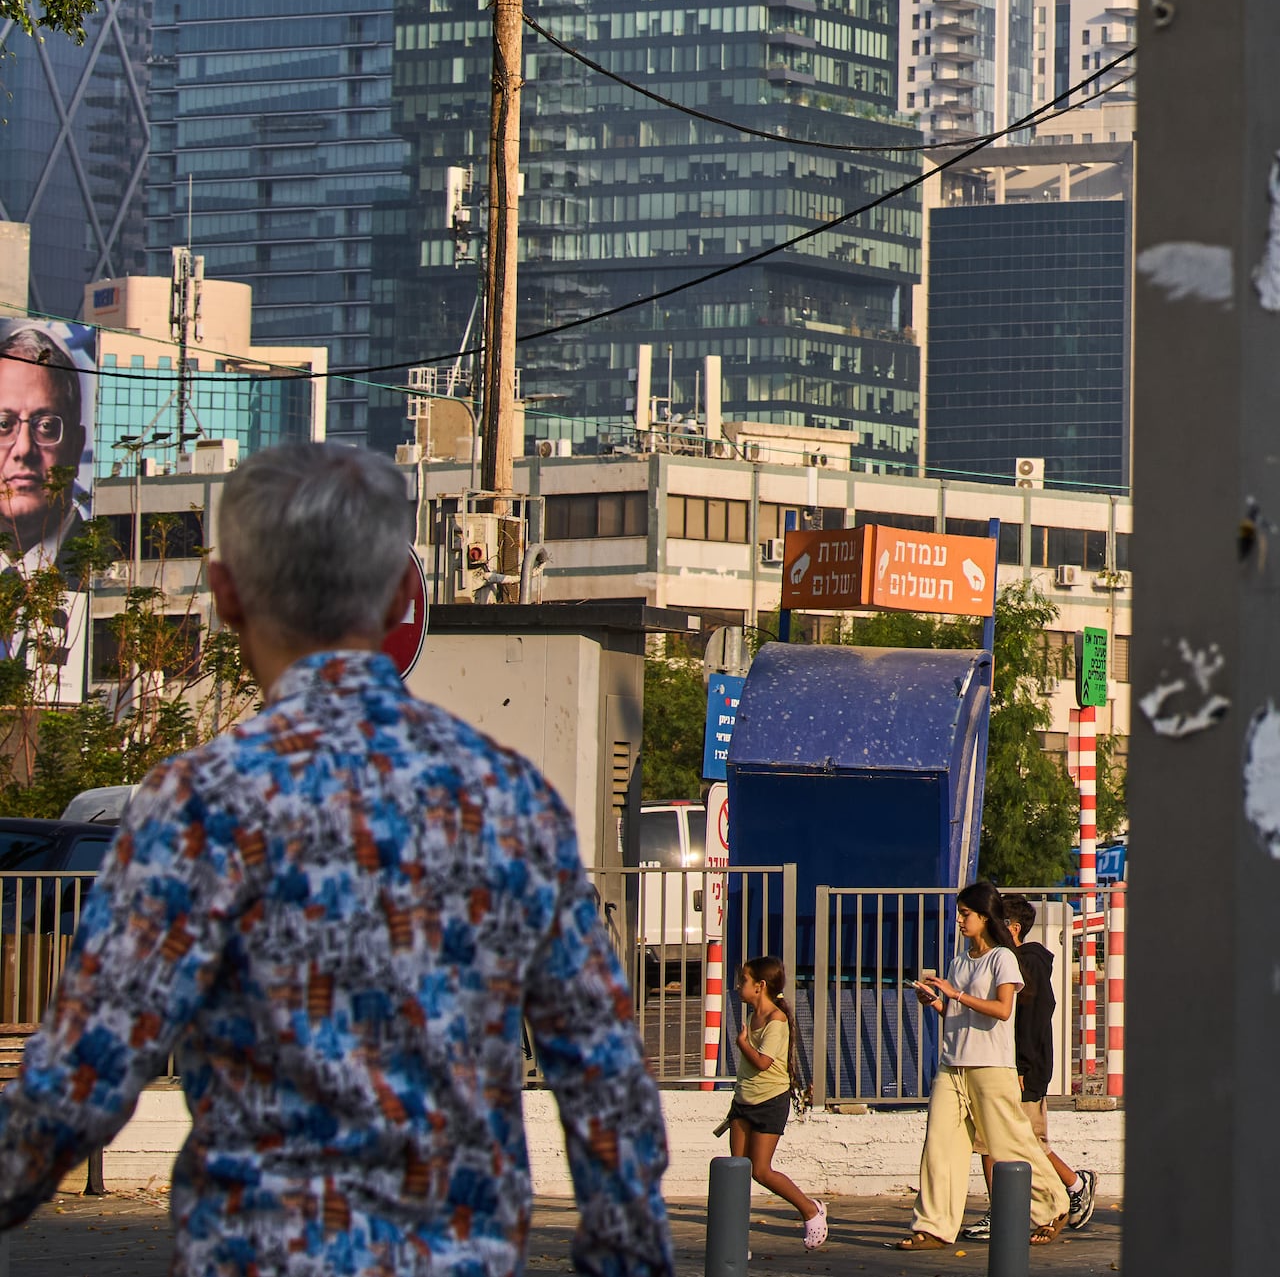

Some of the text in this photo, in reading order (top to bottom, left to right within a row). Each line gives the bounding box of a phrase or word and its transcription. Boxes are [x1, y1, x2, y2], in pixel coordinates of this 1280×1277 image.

[818, 539, 856, 563] עמדת
[894, 540, 947, 567] עמדת
[812, 571, 856, 596] תשלום
[889, 572, 953, 601] תשלום
